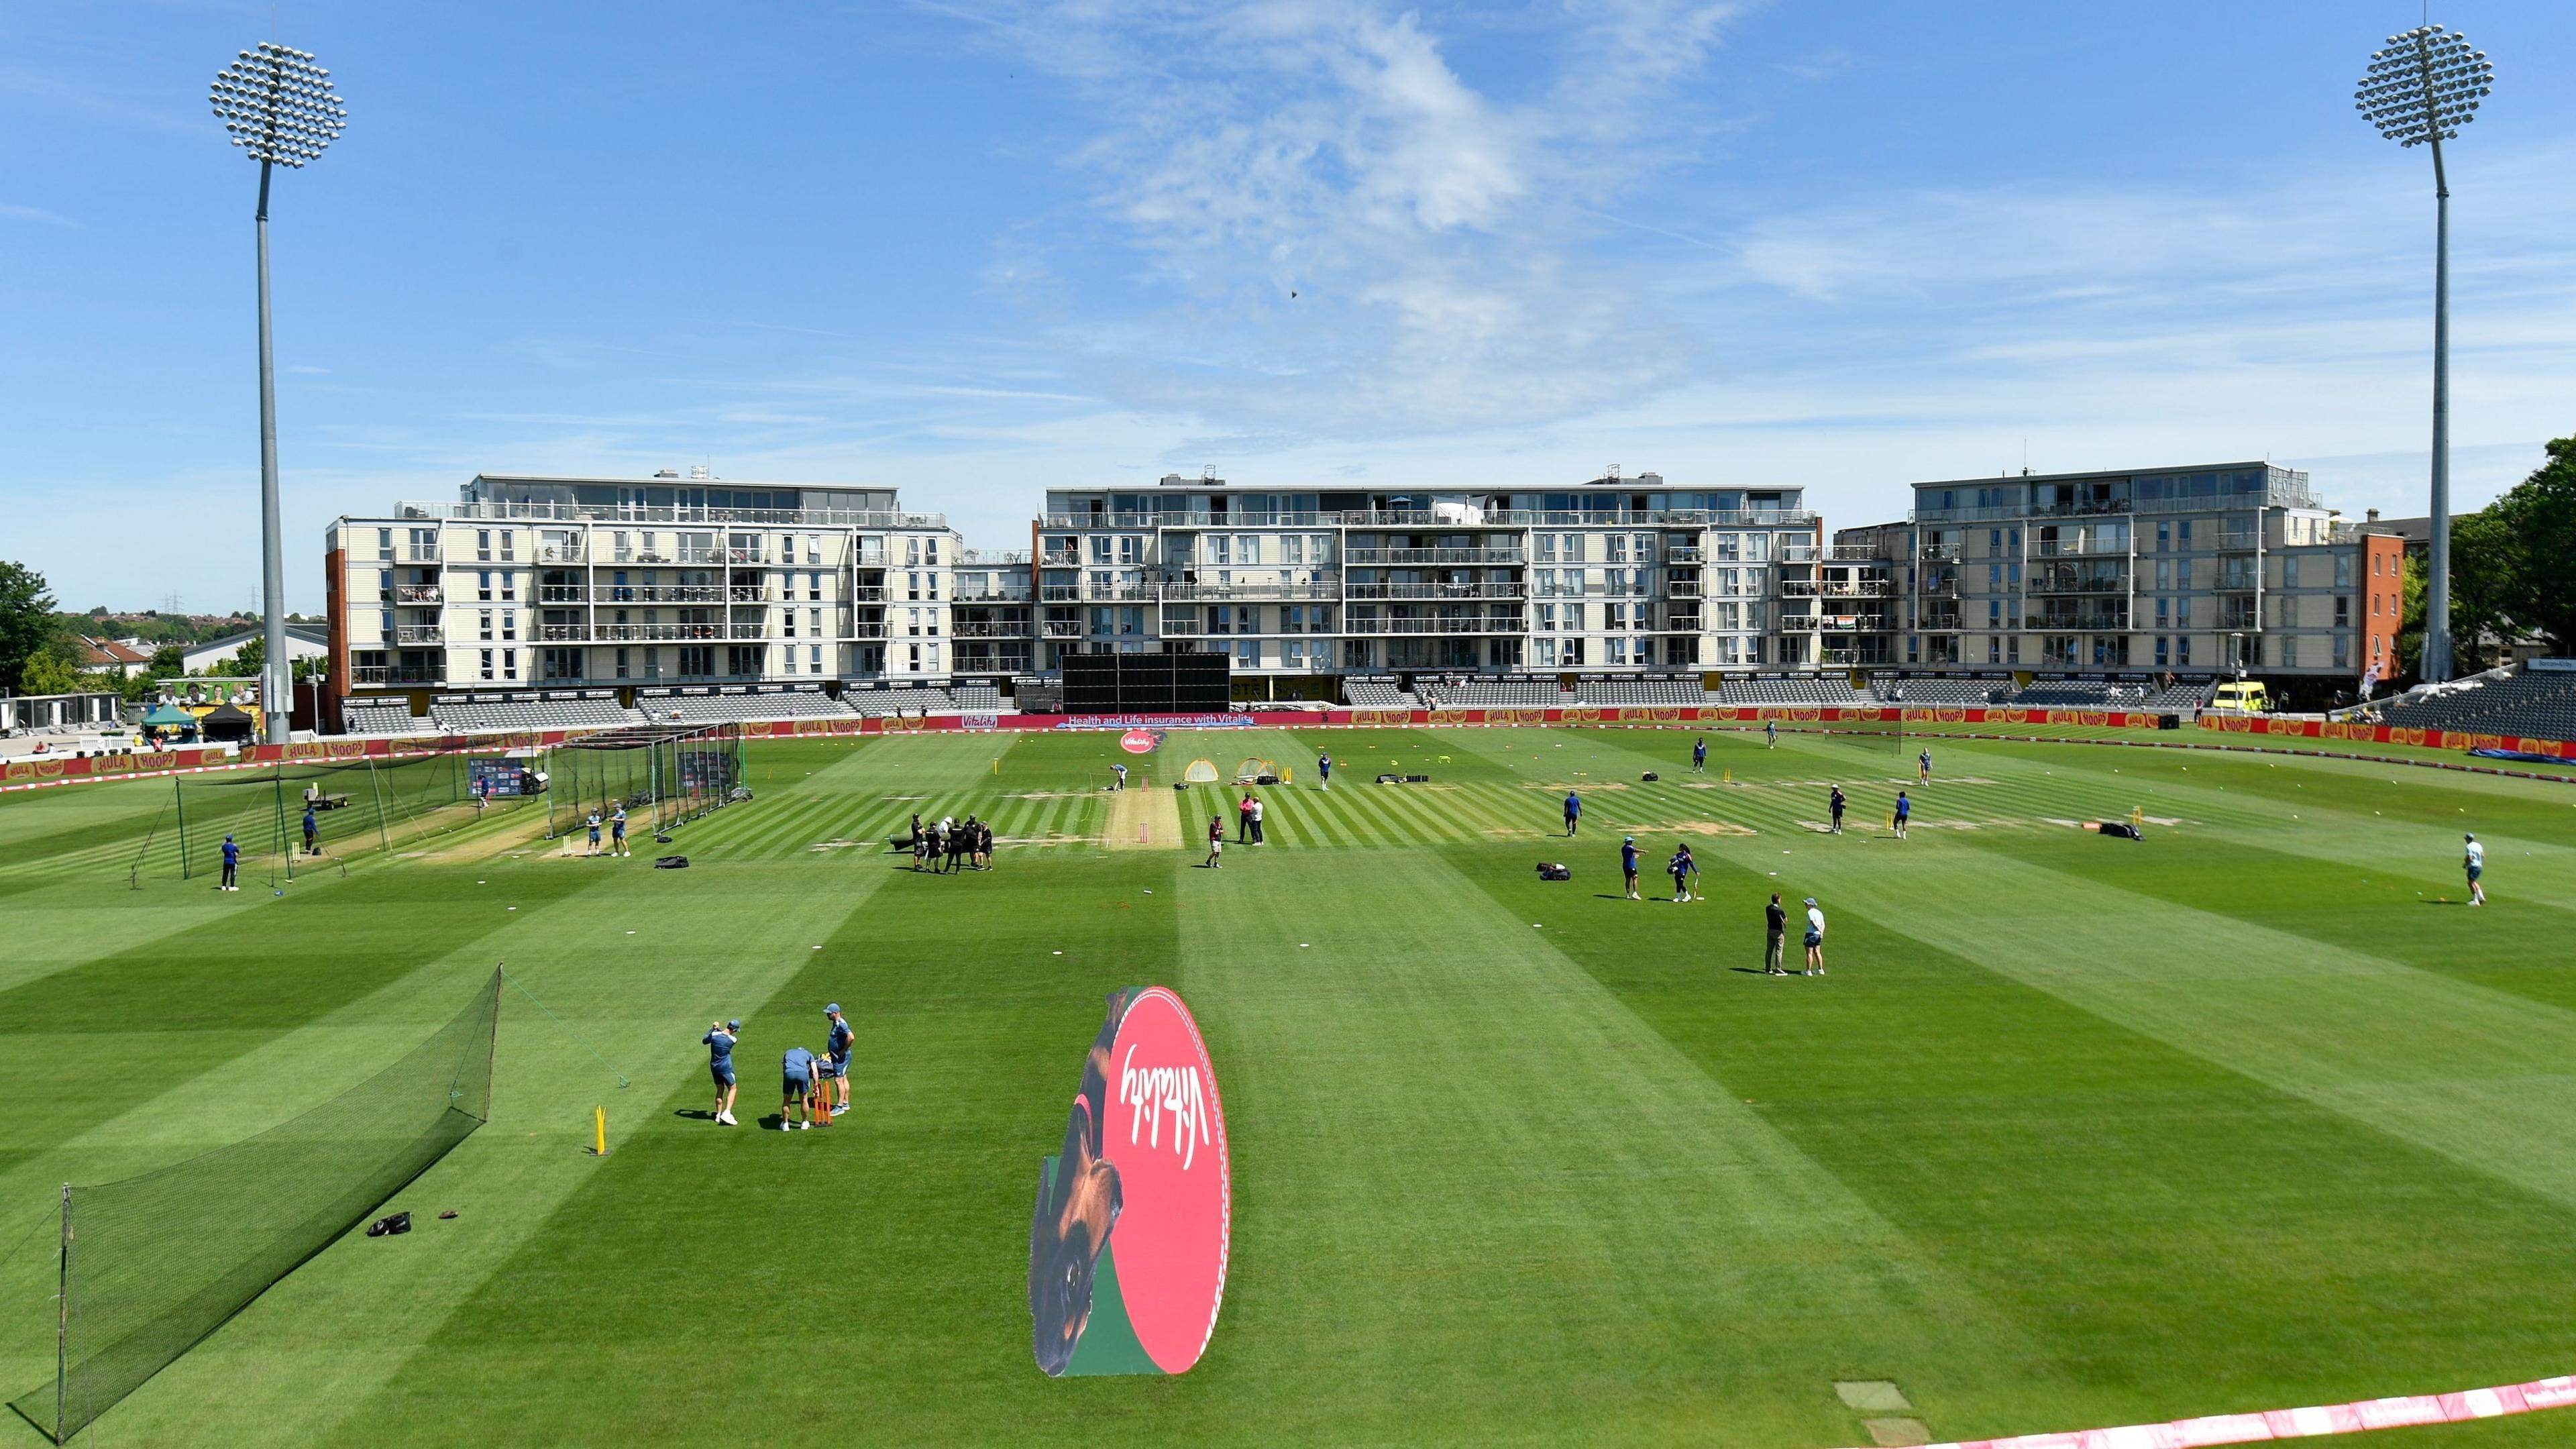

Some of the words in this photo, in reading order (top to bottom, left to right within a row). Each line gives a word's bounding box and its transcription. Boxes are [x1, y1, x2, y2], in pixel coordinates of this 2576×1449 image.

[1069, 716, 1101, 724] Health
[1104, 715, 1122, 724] and
[1124, 714, 1142, 724] Life
[1144, 715, 1192, 724] insurance
[1195, 714, 1216, 723] with
[1218, 714, 1254, 724] Vitality
[1356, 712, 1375, 722] HULA
[1385, 711, 1408, 722] HOOPS
[1490, 712, 1510, 722] HULA
[1519, 711, 1542, 721] HOOPS
[1624, 709, 1643, 720] HULA
[1654, 709, 1678, 720] HOOPS
[1763, 708, 1782, 720] HULA
[1794, 709, 1818, 720] HOOPS
[1907, 710, 1927, 720] HULA
[1938, 710, 1963, 722] HOOPS
[2053, 711, 2072, 722] HULA
[2083, 713, 2105, 725] HOOPS
[800, 722, 821, 732] HULA
[834, 720, 859, 732] HOOPS
[906, 718, 924, 727] HOOPS
[963, 716, 996, 727] Vitality
[2226, 719, 2249, 731] HOOPS
[2324, 724, 2342, 736] HULA
[2352, 725, 2373, 737] HOOPS
[513, 733, 539, 745] HOOPS
[2447, 735, 2464, 747] HULA
[2475, 736, 2498, 749] HOOPS
[289, 745, 317, 757] HULA
[333, 742, 362, 755] HOOPS
[99, 758, 126, 770] HULA
[141, 753, 172, 767] HOOPS
[206, 752, 225, 761] HULA
[10, 767, 30, 775] HULA
[40, 763, 62, 773] HOOPS
[1120, 1044, 1209, 1170] Vitality
